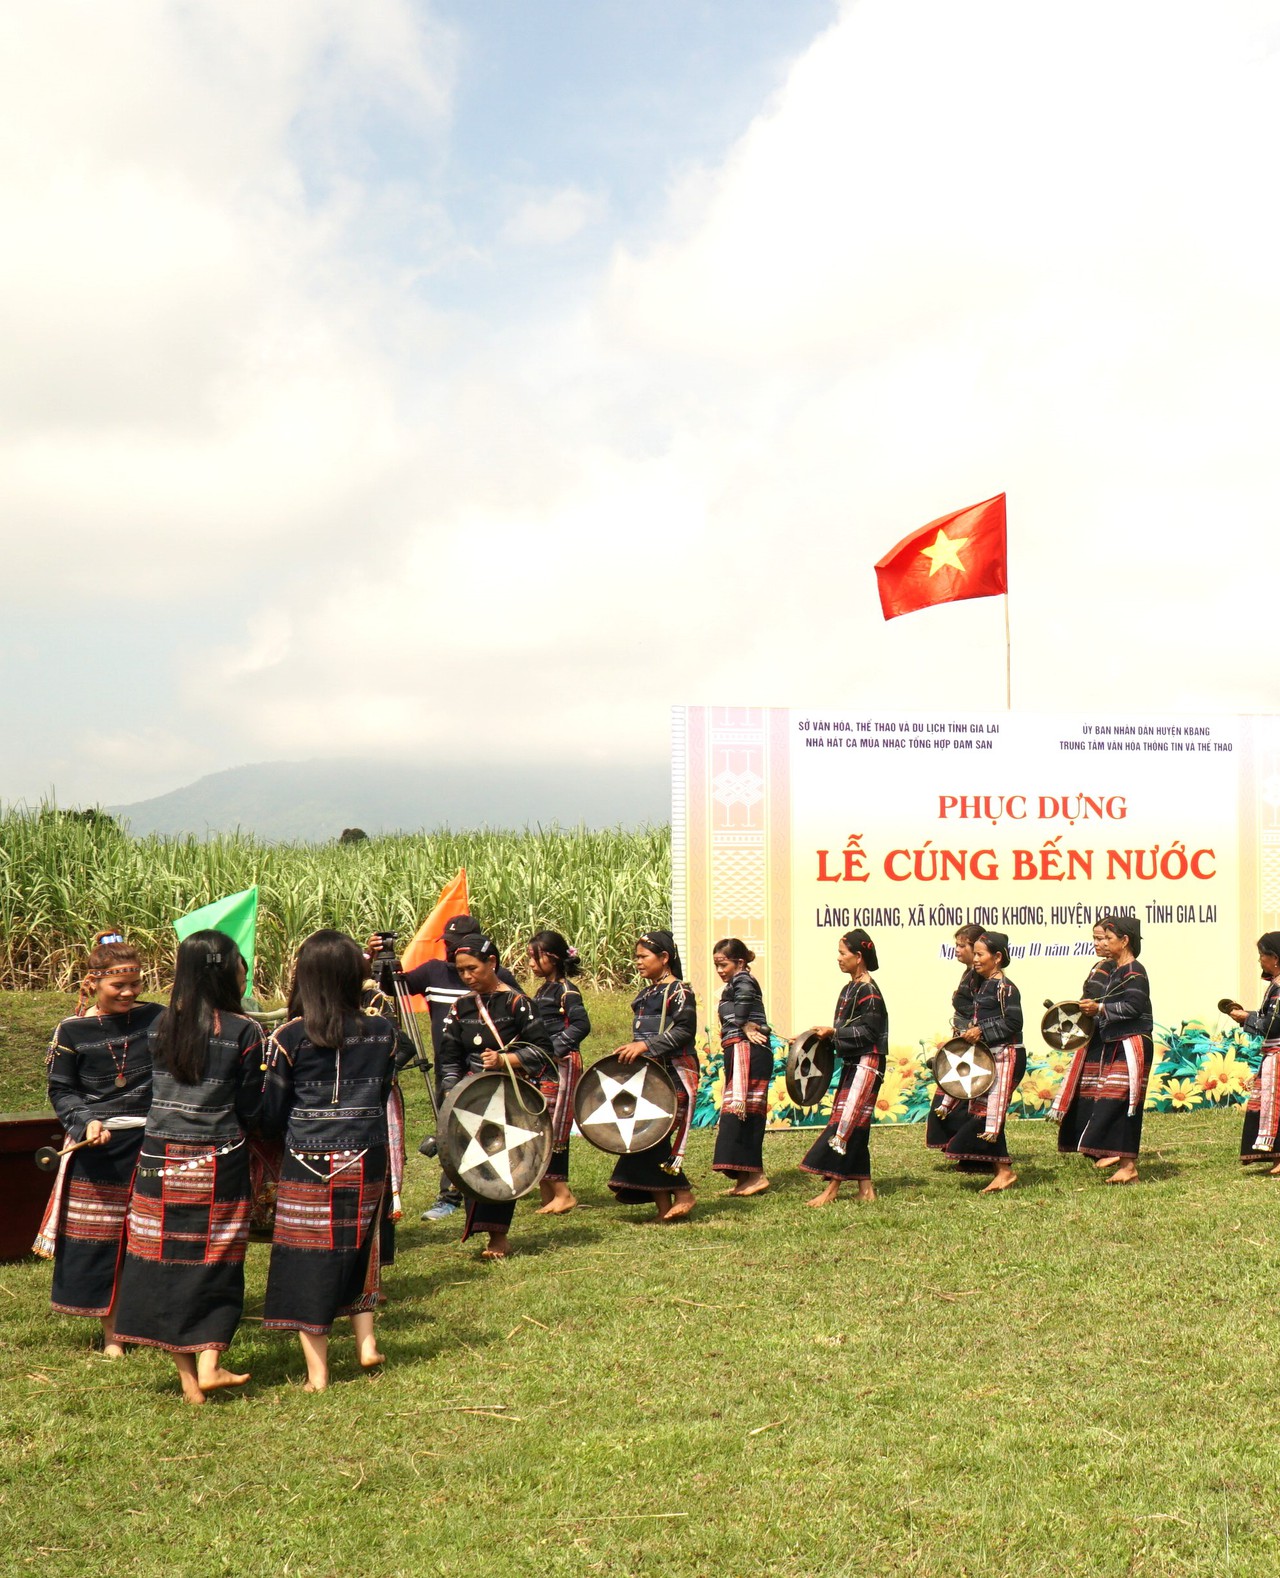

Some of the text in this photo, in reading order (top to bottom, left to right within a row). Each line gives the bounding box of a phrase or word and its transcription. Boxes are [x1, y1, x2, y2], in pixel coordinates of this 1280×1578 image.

[798, 718, 810, 731] SỞ
[812, 720, 831, 731] VĂN
[874, 722, 896, 732] THAO
[898, 721, 910, 733] VÀ
[912, 722, 924, 733] DU
[926, 723, 945, 735] LỊCH
[970, 723, 984, 734] GIA
[986, 724, 1000, 734] LAI
[1095, 725, 1112, 736] BAN
[1113, 724, 1136, 736] NHÂN
[1138, 724, 1154, 736] DÂN
[1156, 724, 1182, 738] HUYỆN
[1184, 726, 1210, 736] KBANG
[805, 736, 824, 748] NHÀ
[826, 736, 843, 748] HÁT
[845, 738, 857, 748] CA
[860, 736, 880, 748] MÚA
[882, 738, 906, 751] NHẠC
[933, 738, 951, 751] HỢP
[975, 740, 993, 750] SAN
[1059, 740, 1086, 751] TRUNG
[1088, 739, 1105, 751] TÂM
[1107, 740, 1123, 751] VĂN
[1143, 740, 1169, 752] THÔNG
[1171, 742, 1183, 752] TIN
[1185, 740, 1196, 752] VÀ
[1214, 742, 1233, 752] THAO
[937, 792, 1128, 826] PHỤC DỰNG
[816, 833, 1217, 883] LỄ CÚNG BẾN NƯỚC
[816, 904, 850, 928] LÀNG
[853, 907, 904, 929] KGIANG,
[908, 904, 926, 927] XÃ
[929, 903, 963, 926] KÔNG
[1002, 905, 1047, 927] KHƠNG,
[1051, 902, 1092, 928] HUYỆN
[1145, 899, 1173, 924] TỈNH
[1176, 905, 1196, 923] GIA
[1199, 905, 1217, 923] LAI
[1029, 942, 1042, 957] 10
[1044, 943, 1070, 957] năm
[1073, 942, 1096, 957] 202
